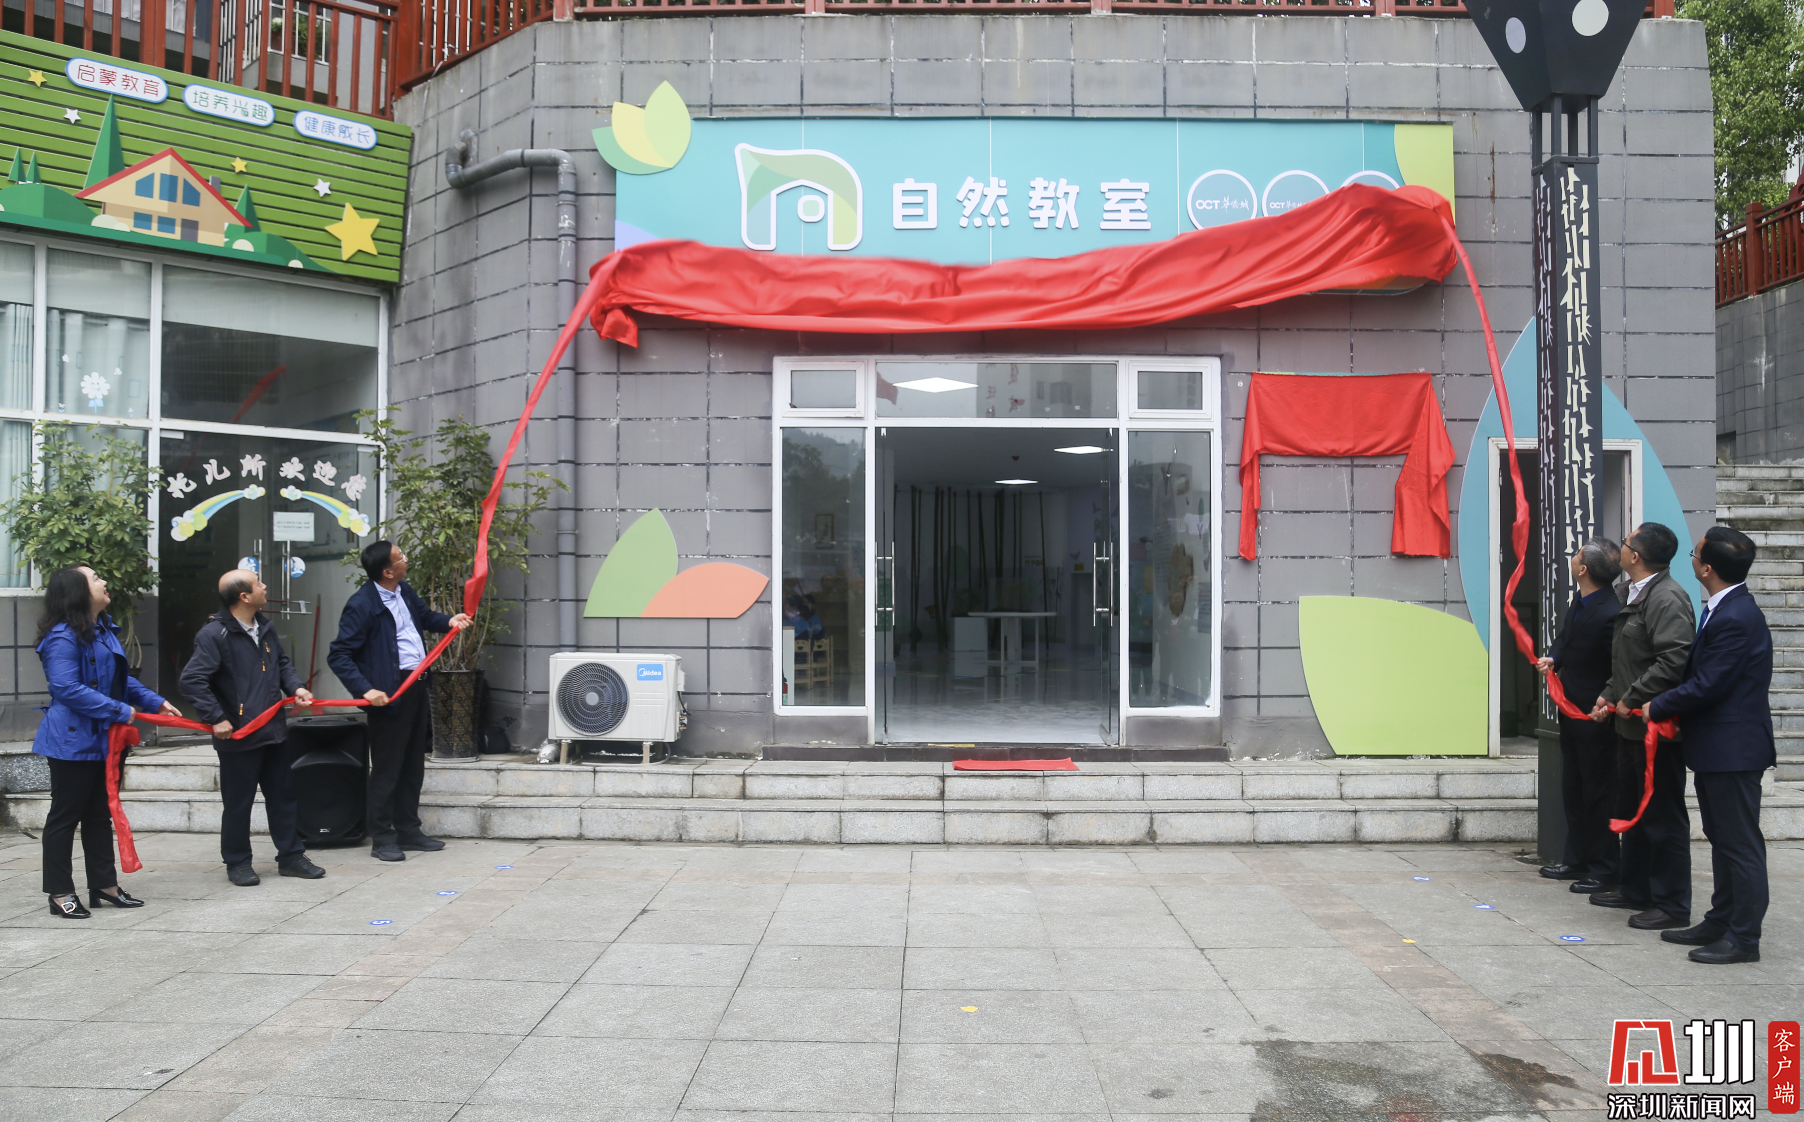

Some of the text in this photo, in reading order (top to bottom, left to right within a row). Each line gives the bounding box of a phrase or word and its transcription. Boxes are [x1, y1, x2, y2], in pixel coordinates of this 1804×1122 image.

[77, 64, 160, 97] 启蒙教育
[192, 90, 269, 121] 培养兴趣
[304, 116, 370, 144] 健康成长
[893, 176, 1151, 230] 自然教室
[1195, 199, 1220, 210] OCT
[1269, 201, 1285, 209] OCT
[639, 667, 662, 677] Midea
